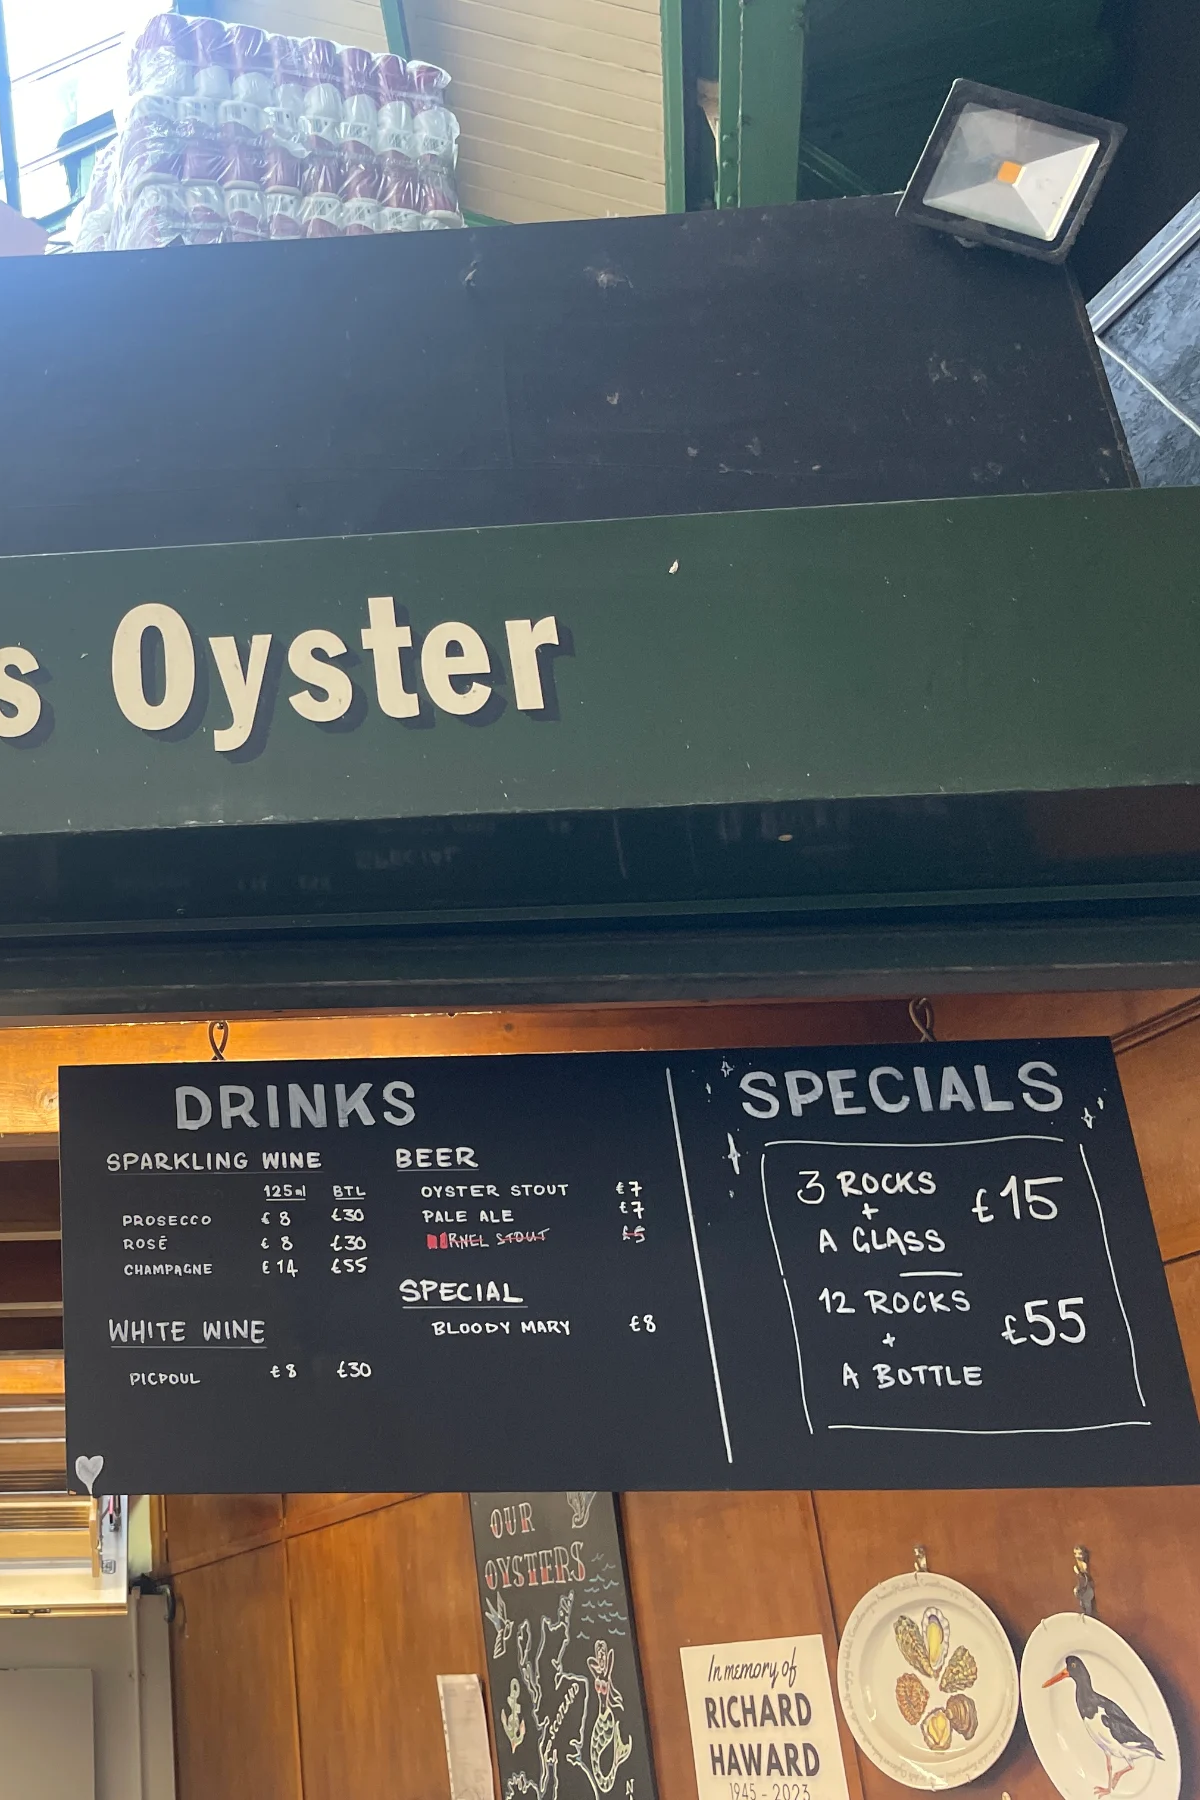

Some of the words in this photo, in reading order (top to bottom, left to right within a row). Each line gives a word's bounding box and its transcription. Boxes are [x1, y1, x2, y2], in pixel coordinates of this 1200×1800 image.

[111, 596, 560, 753] Oyster
[740, 1060, 1064, 1118] SPECIALS
[175, 1080, 416, 1130] DRINKS
[107, 1152, 248, 1172] SPARKLING
[262, 1152, 322, 1170] WINE
[395, 1147, 479, 1169] BEER
[332, 1185, 367, 1198] BTL
[420, 1184, 500, 1199] OYSTER
[510, 1183, 569, 1197] STOUT
[796, 1170, 825, 1205] 3
[836, 1170, 937, 1196] ROCKS
[972, 1175, 1064, 1223] £15
[122, 1214, 213, 1227] PROSECCO
[331, 1207, 365, 1222] £30
[422, 1209, 468, 1223] PALE
[479, 1209, 515, 1223] ALE
[330, 1234, 367, 1251] £30
[426, 1231, 489, 1250] RNEL
[818, 1227, 838, 1254] A
[852, 1227, 946, 1256] GLASS
[124, 1262, 213, 1277] CHAMPAGNE
[331, 1257, 368, 1274] £55
[399, 1278, 524, 1304] SPECIAL
[818, 1288, 856, 1315] 12
[864, 1289, 971, 1315] ROCKS
[108, 1318, 186, 1344] WHITE
[203, 1319, 266, 1344] WINE
[432, 1320, 511, 1336] BLOODY
[521, 1320, 571, 1336] MARY
[629, 1314, 657, 1333] £8
[1001, 1297, 1087, 1346] £55
[129, 1372, 201, 1386] PICPOUL
[270, 1363, 297, 1379] £8
[336, 1360, 372, 1379] £30
[842, 1363, 860, 1389] A
[872, 1364, 983, 1389] BOTTLE
[490, 1502, 535, 1538] OUR
[484, 1541, 586, 1590] OYSTERS
[707, 1654, 722, 1682] In
[724, 1661, 780, 1689] memory
[781, 1646, 798, 1688] of
[549, 1682, 579, 1740] SCOTLAND
[704, 1692, 813, 1729] RICHARD
[709, 1742, 821, 1777] HAWARD
[729, 1782, 757, 1800] 1945
[772, 1783, 811, 1800] 2023
